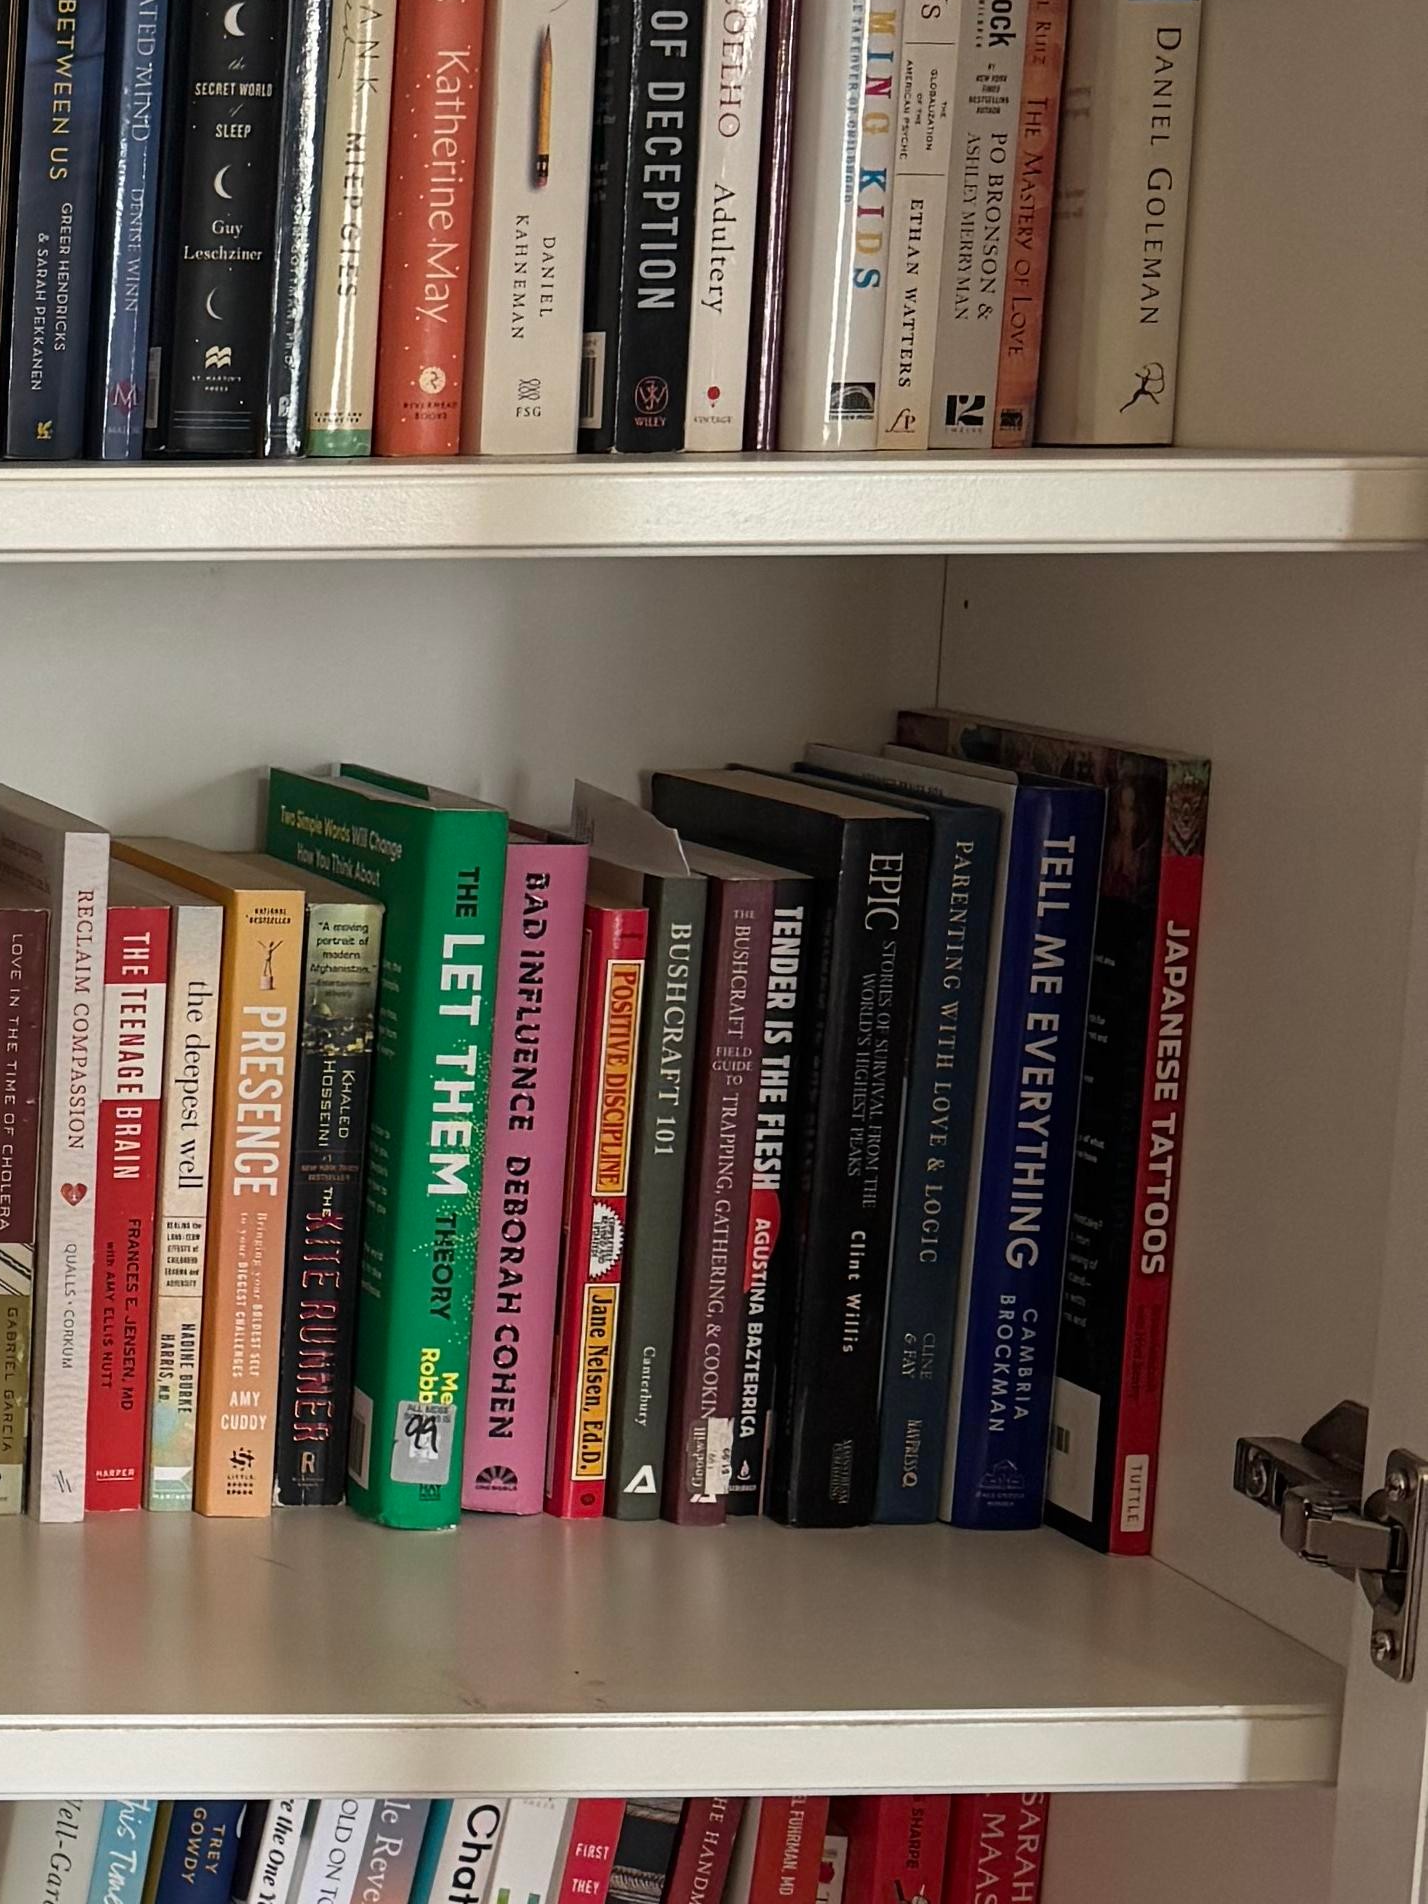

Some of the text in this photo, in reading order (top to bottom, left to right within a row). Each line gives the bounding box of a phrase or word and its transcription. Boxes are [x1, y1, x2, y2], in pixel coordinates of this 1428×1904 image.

[1140, 27, 1181, 326] DANIEL GOLEMAN
[184, 245, 263, 262] Leschziner
[212, 219, 244, 239] Guy
[512, 214, 529, 340] KAHNEMAN
[542, 236, 555, 318] DANIEL
[515, 406, 542, 418] FSG
[317, 1059, 336, 1148] HOSSEINI
[338, 1069, 355, 1139] KHALED
[842, 1230, 866, 1355] Clint Willis
[230, 1391, 262, 1408] AMY
[635, 1345, 655, 1428] Canterbury
[221, 1413, 266, 1431] CUDDY
[1127, 1464, 1144, 1525] TUTTLE
[577, 1842, 609, 1860] FIRST
[572, 1877, 599, 1894] THEY
